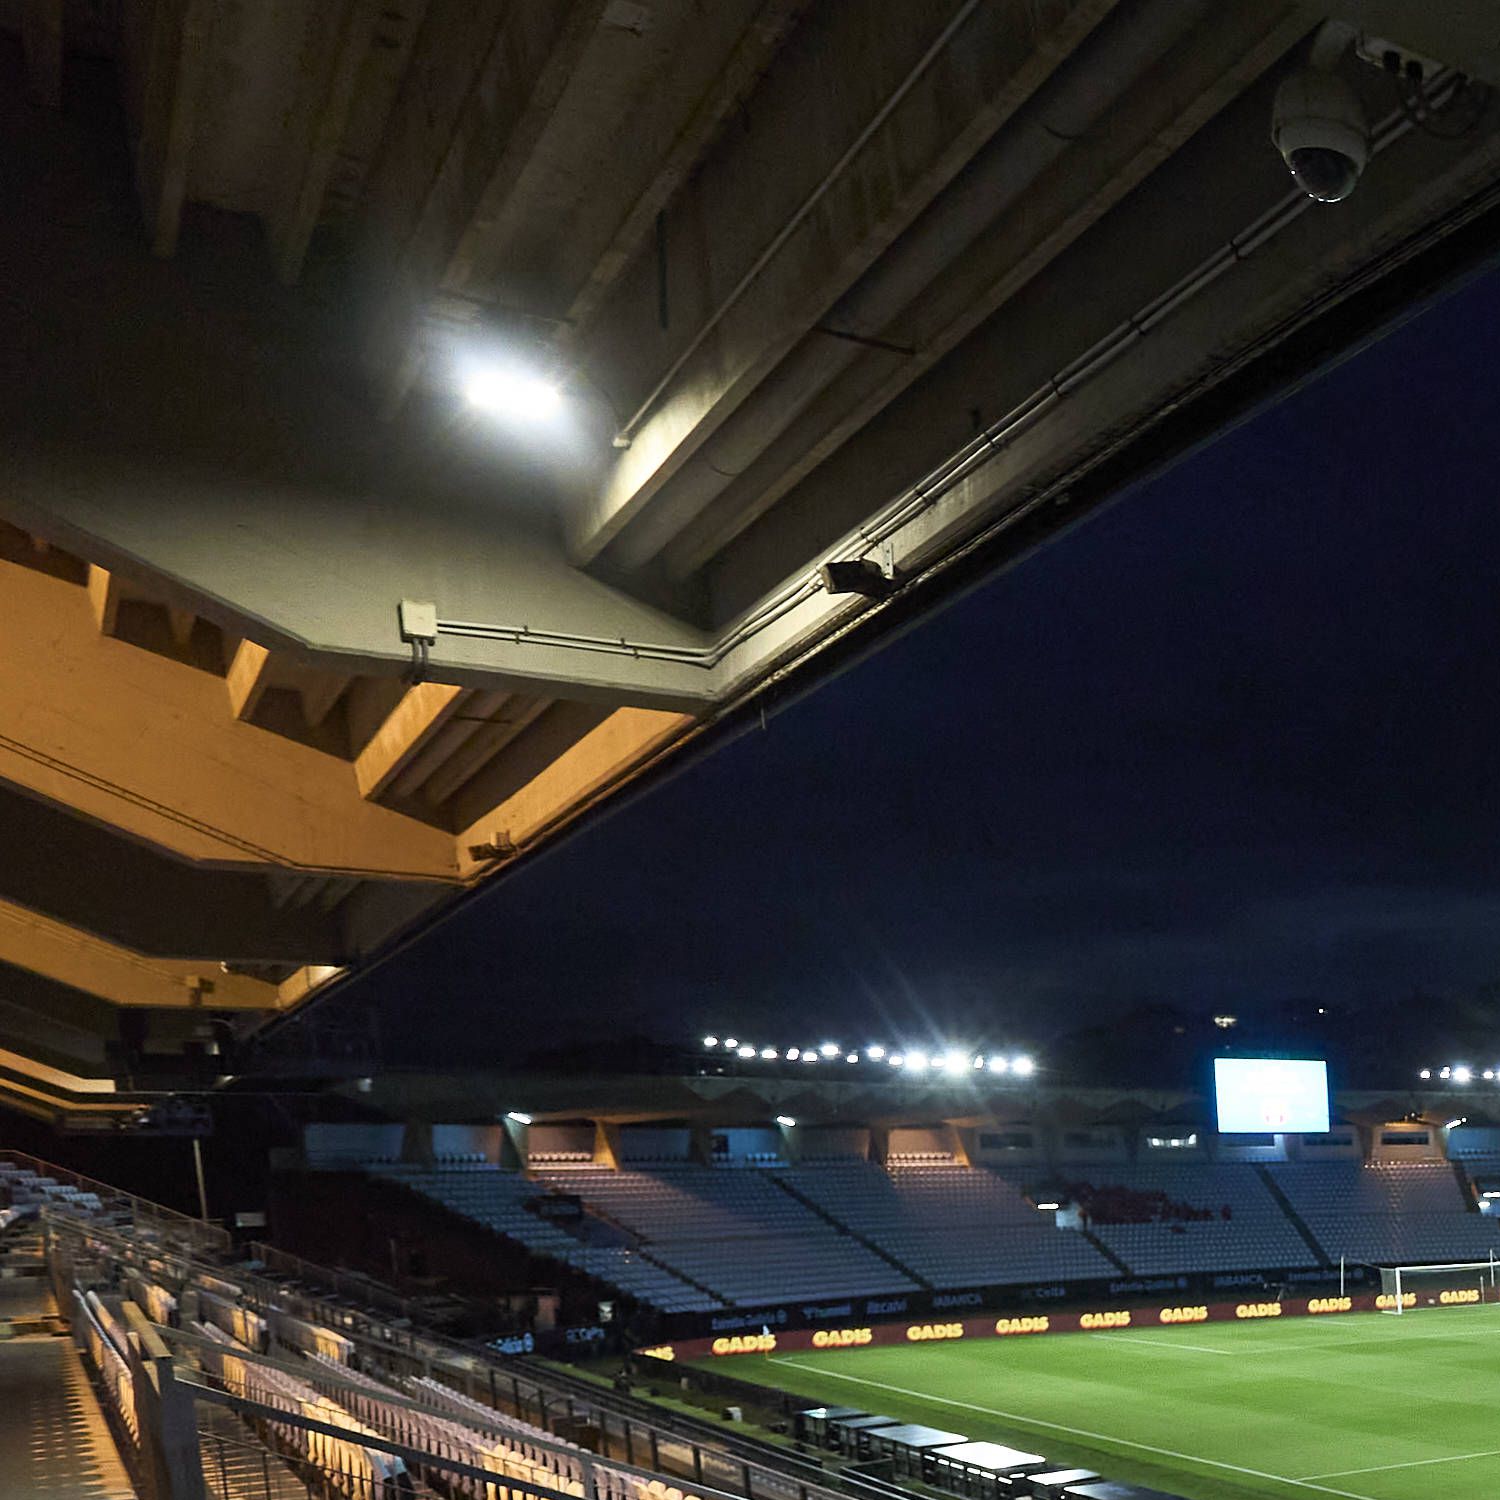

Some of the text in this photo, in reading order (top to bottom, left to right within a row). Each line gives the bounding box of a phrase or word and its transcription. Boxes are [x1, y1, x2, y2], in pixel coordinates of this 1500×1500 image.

[1307, 1296, 1352, 1314] GADIS
[1440, 1288, 1480, 1304] GADIS
[1080, 1310, 1131, 1329] GADIS
[1159, 1305, 1209, 1324] GADIS
[1235, 1301, 1282, 1319] GADIS
[906, 1322, 965, 1342] GADIS
[995, 1316, 1050, 1335] GADIS
[712, 1333, 777, 1357] GADIS
[812, 1327, 873, 1348] GADIS
